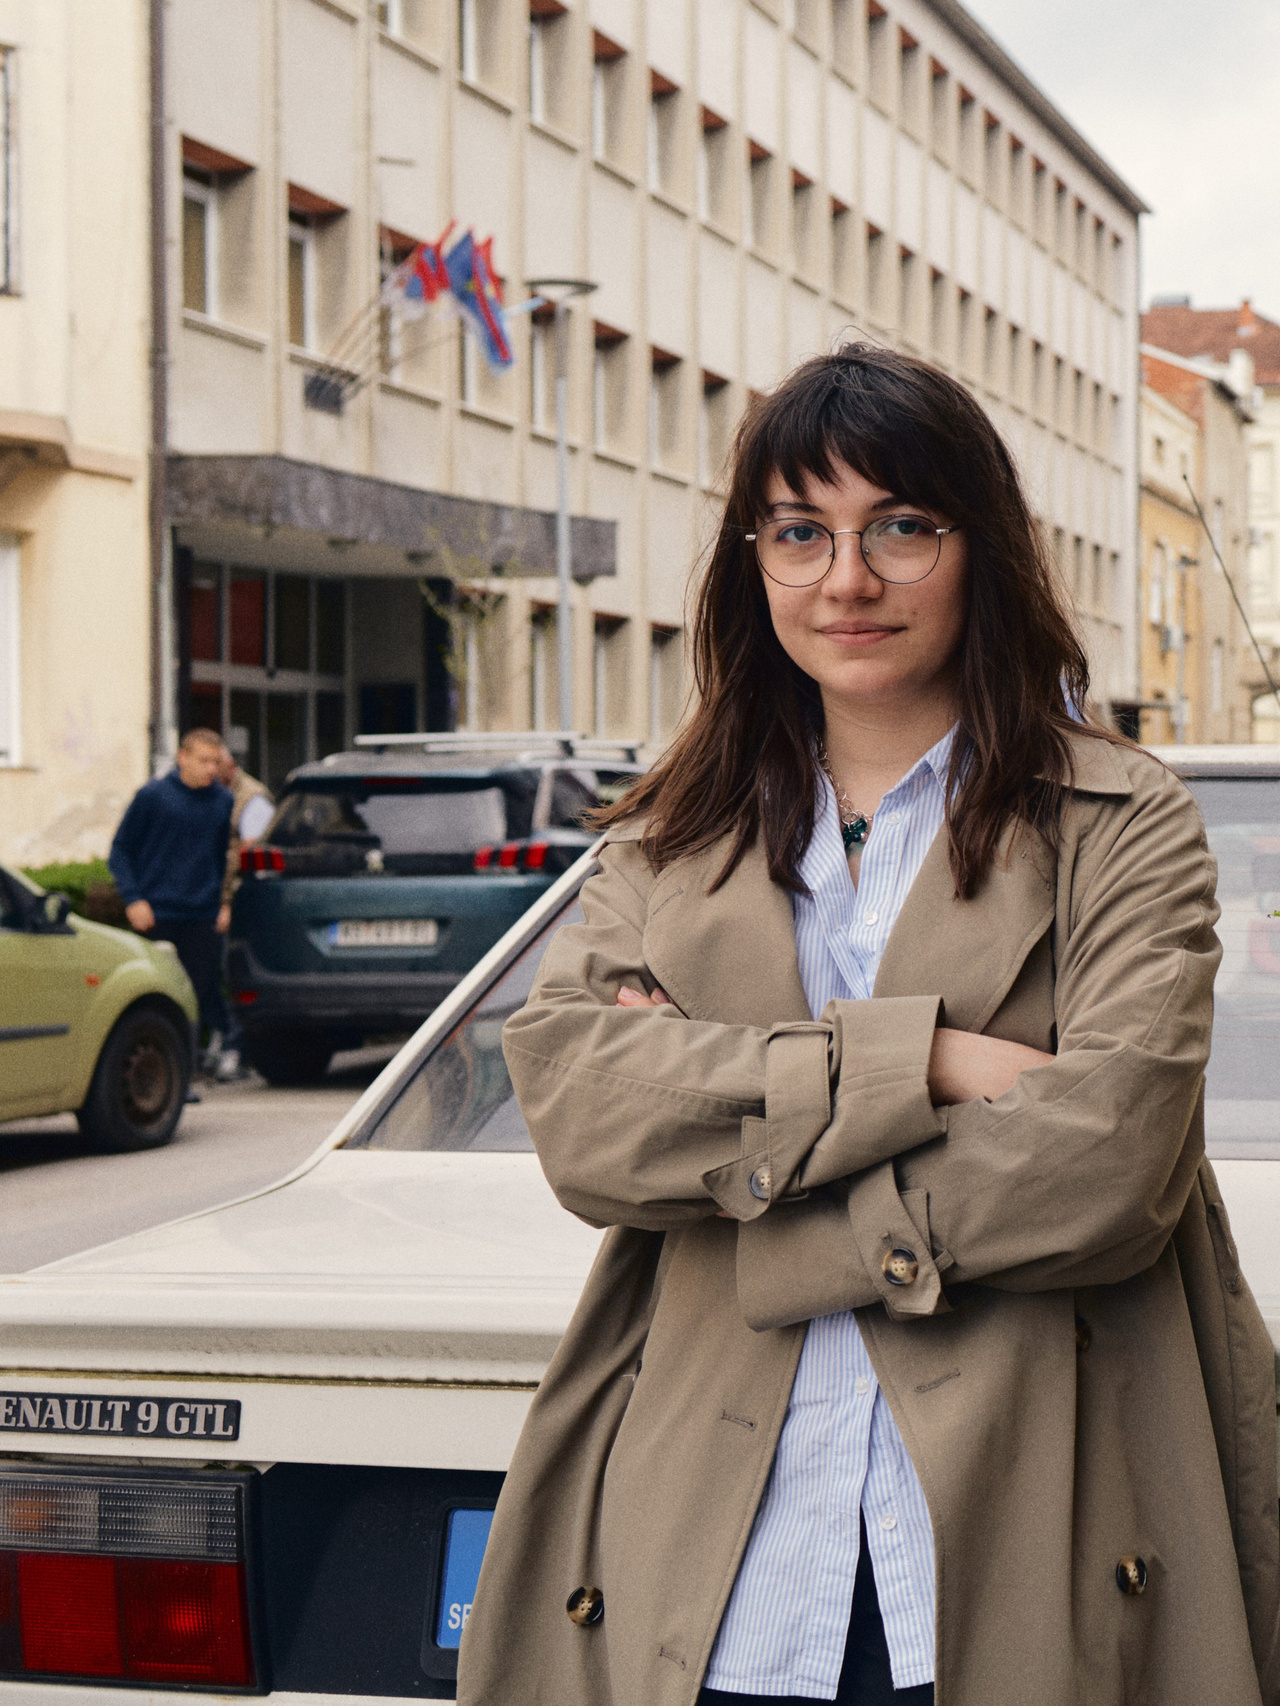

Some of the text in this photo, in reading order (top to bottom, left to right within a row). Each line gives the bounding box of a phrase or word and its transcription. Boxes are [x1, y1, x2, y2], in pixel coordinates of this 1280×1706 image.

[0, 1396, 233, 1436] ENAULT 9 GTL
